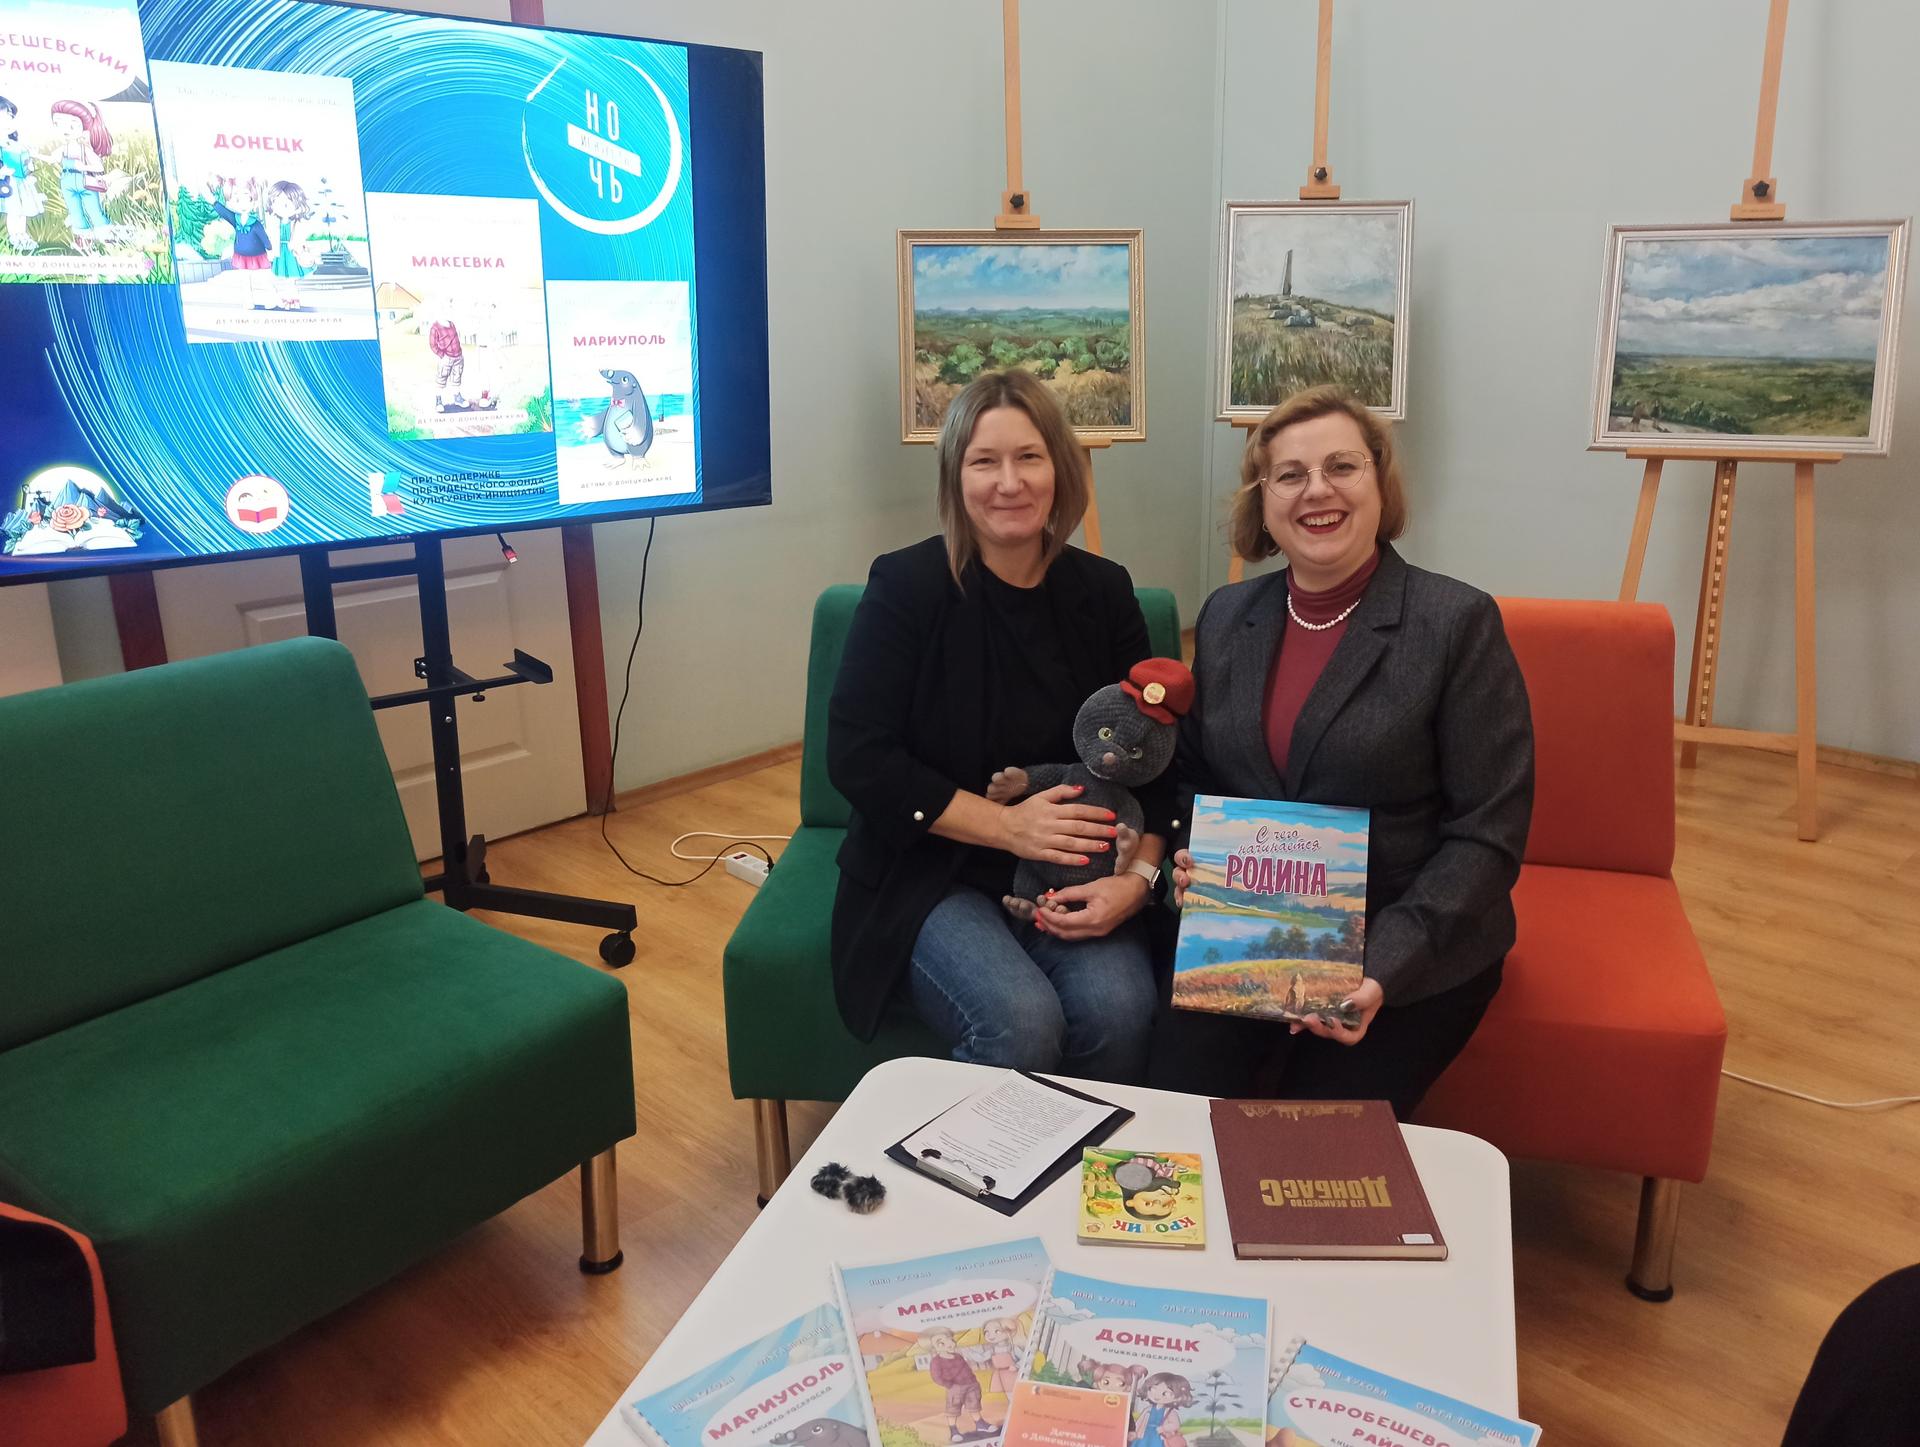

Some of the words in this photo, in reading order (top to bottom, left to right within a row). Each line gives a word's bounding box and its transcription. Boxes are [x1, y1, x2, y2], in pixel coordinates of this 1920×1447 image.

[213, 133, 305, 153] ДОНЕЦК
[411, 255, 506, 269] МАКЕЕВКА
[573, 334, 666, 347] МАРИУПОЛЬ
[411, 475, 434, 485] ПРИ
[436, 470, 501, 482] ПОДДЕРЖКЕ
[412, 479, 505, 496] ПРЕЗИДЕНТСКОГО
[508, 477, 545, 488] ФОНДА
[413, 491, 483, 506] КУЛЬТУРНЫХ
[485, 486, 546, 500] ИНИЦИАТИВ
[1255, 825, 1269, 844] С
[1273, 829, 1299, 840] чего
[1238, 838, 1322, 855] начинается
[1225, 854, 1328, 898] РОДИНА
[1259, 1175, 1392, 1208] ДОНБАСС
[1290, 1199, 1348, 1208] ВЕЛИЧЕСТВО
[1350, 1199, 1366, 1208] ЕГО
[1112, 1216, 1197, 1234] КРОТИК
[897, 1287, 1016, 1317] МАКЕЕВКА
[1095, 1328, 1200, 1353] ДОНЕЦК
[708, 1360, 845, 1441] МАРИУПОЛЬ
